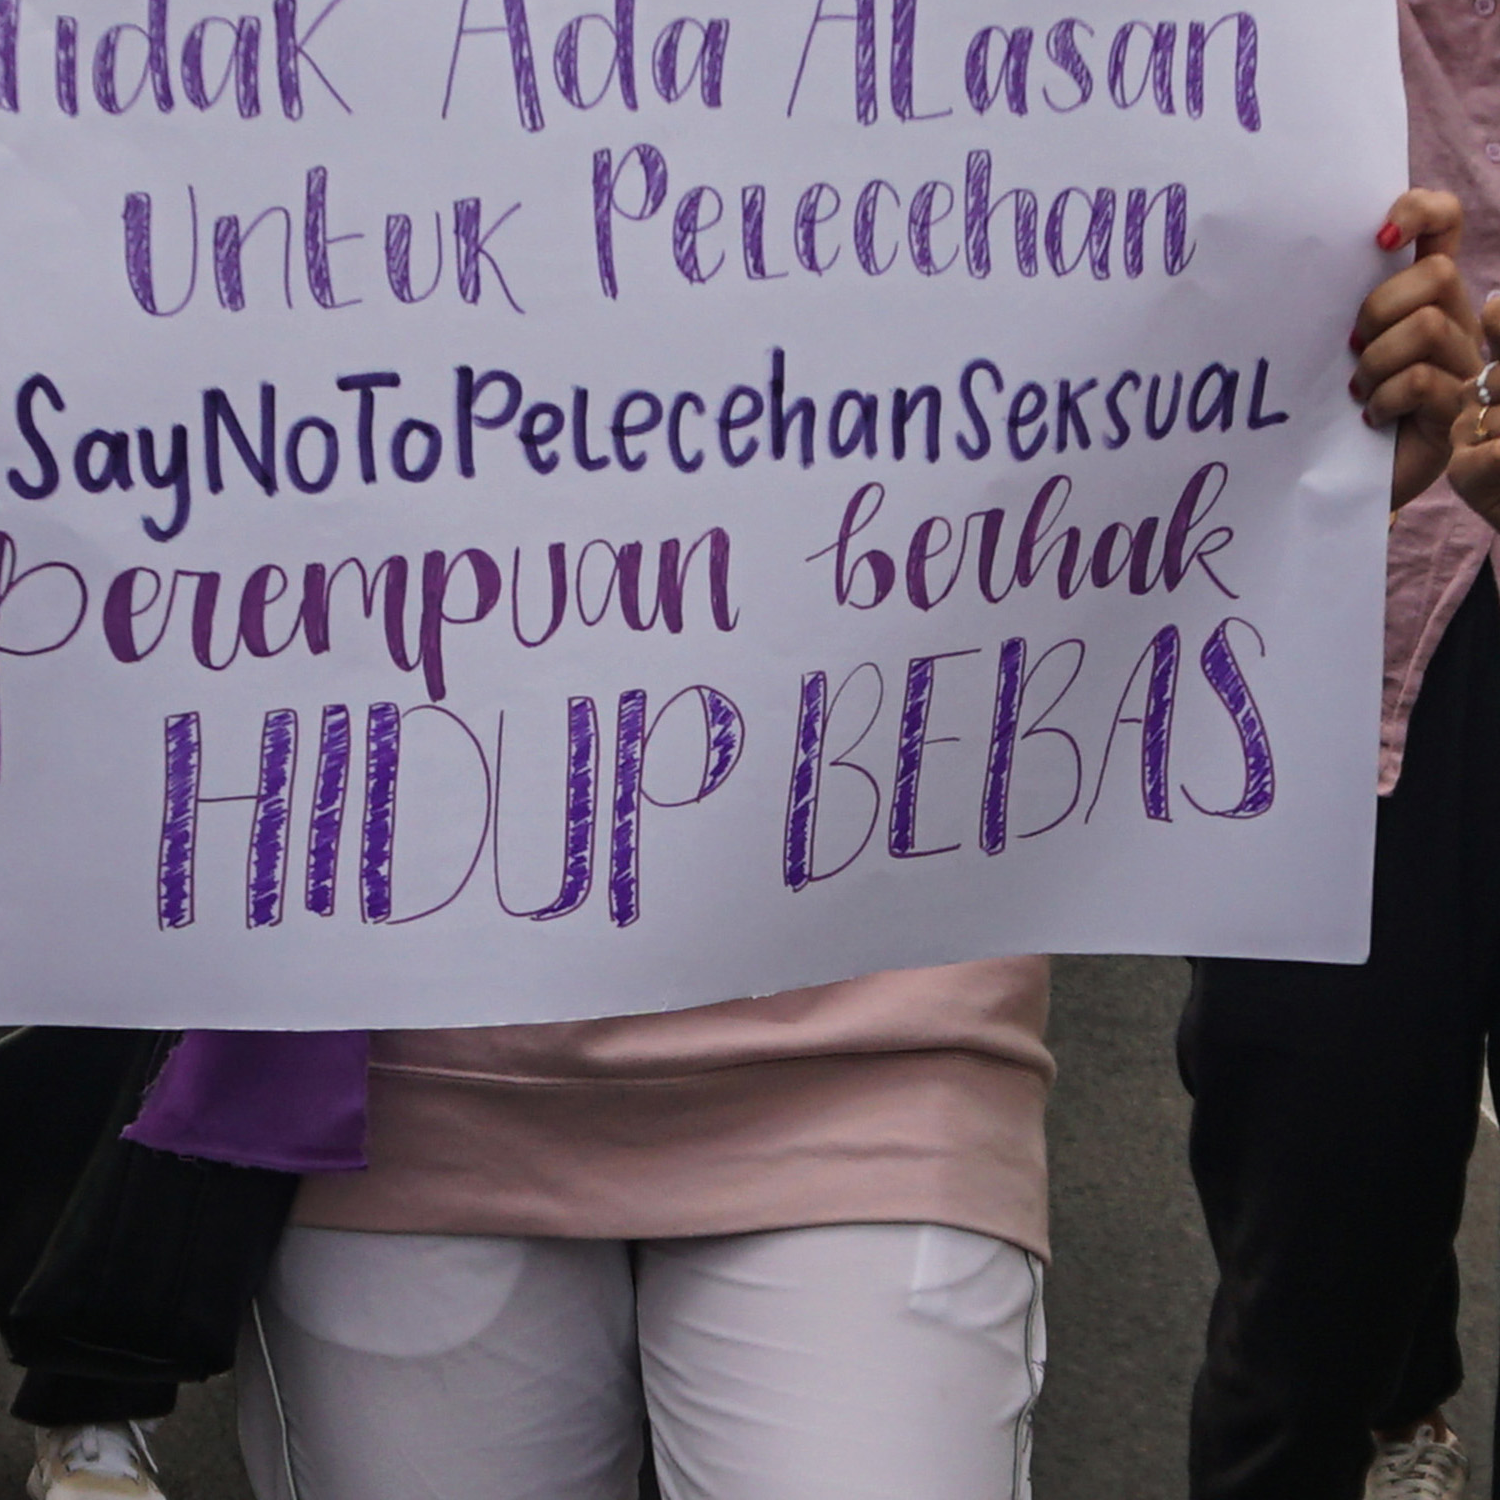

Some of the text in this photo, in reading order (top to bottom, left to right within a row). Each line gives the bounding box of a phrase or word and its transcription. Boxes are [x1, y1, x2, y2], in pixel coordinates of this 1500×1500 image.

[804, 461, 1240, 611] berhak
[156, 615, 1276, 931] HIDUP BEBAS
